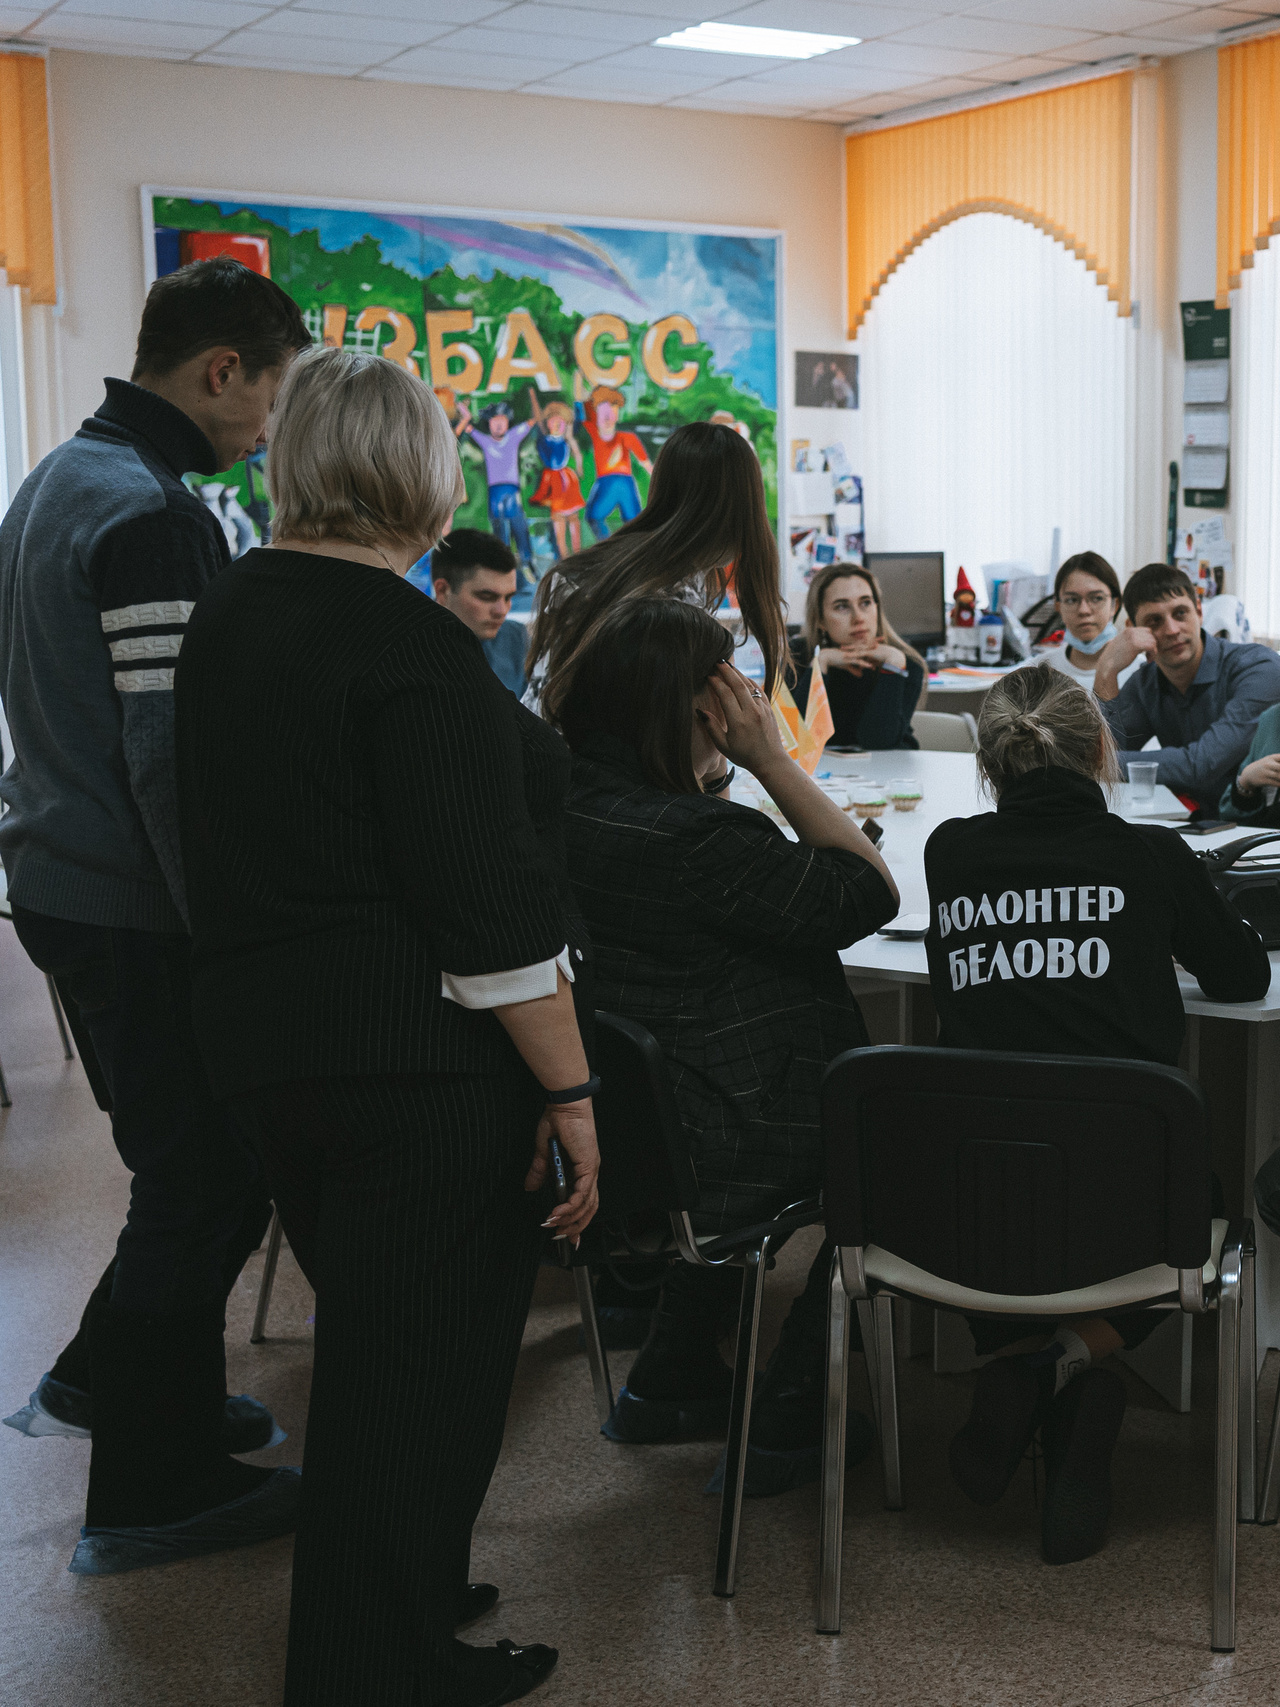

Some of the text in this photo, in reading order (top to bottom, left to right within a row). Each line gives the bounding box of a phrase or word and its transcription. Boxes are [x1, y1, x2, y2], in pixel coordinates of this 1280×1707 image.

[322, 303, 699, 393] ЗБАСС
[937, 885, 1125, 939] ВОЛОНТЕР
[948, 936, 1110, 992] БЕЛОВО
